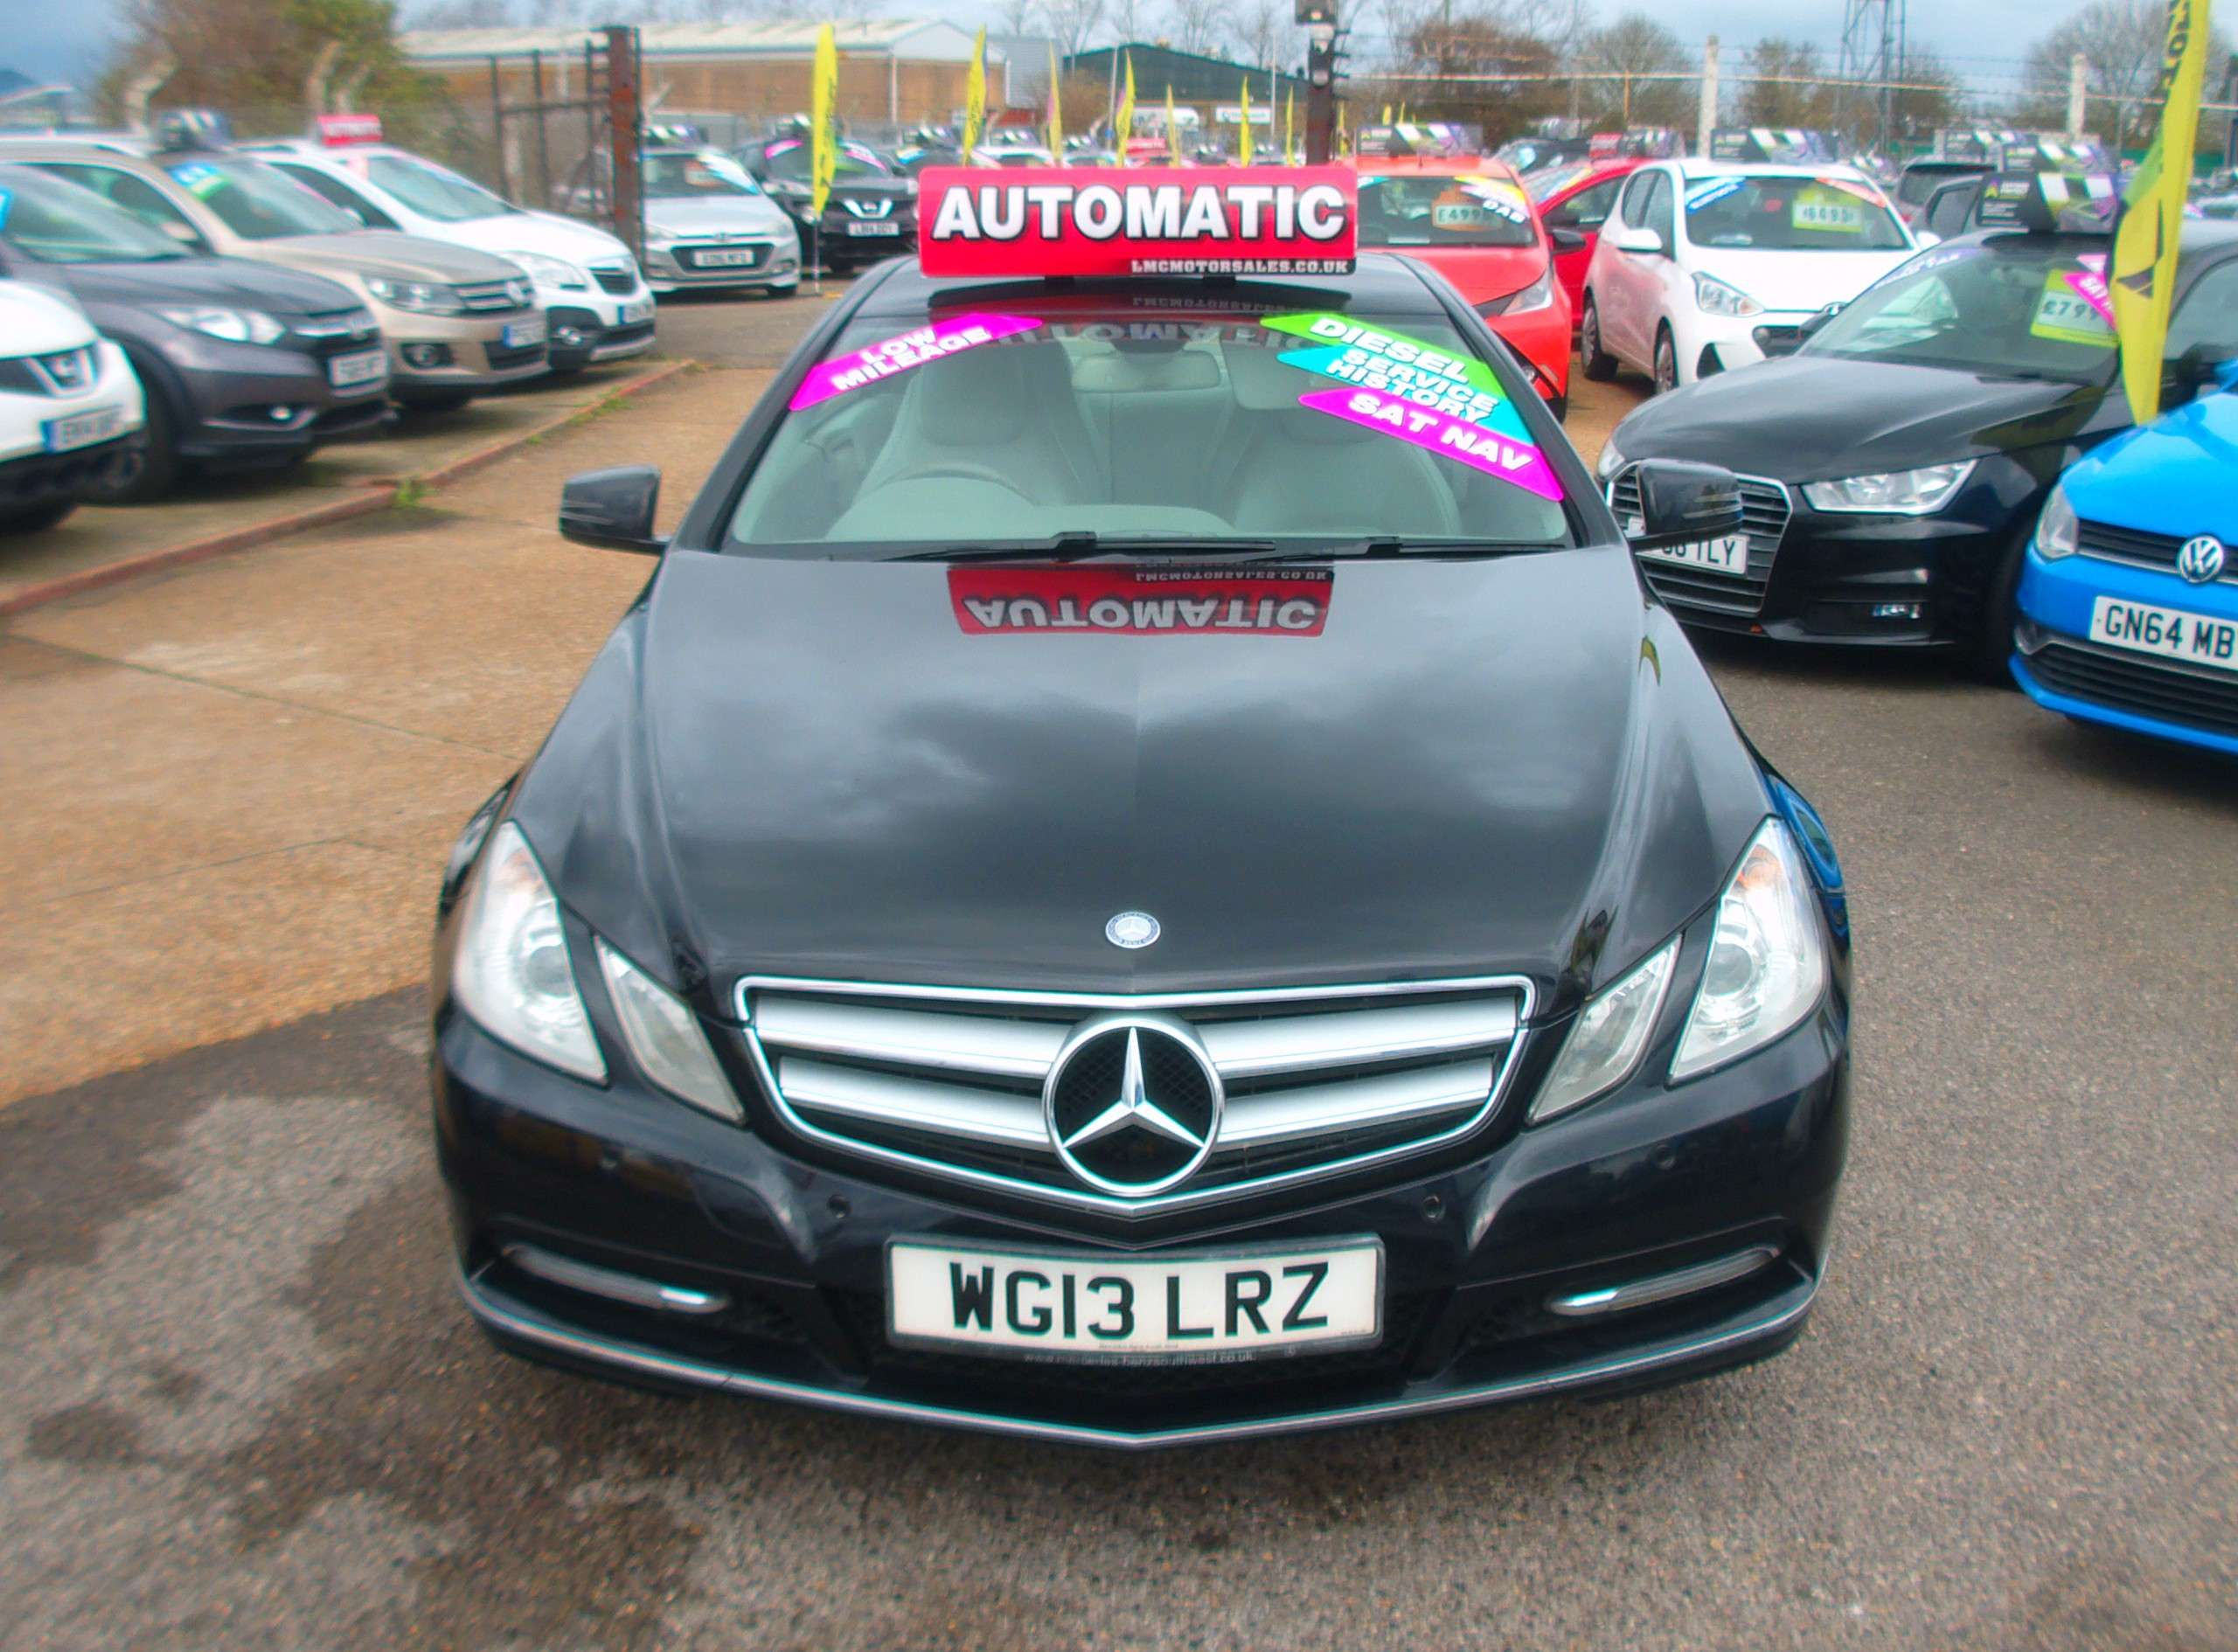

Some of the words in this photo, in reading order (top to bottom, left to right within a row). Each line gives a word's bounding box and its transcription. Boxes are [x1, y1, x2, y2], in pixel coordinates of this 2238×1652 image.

[931, 184, 1346, 241] AUTOMATIC
[1131, 260, 1348, 274] LMCMOTORSALES.CO.UK
[831, 326, 993, 390] MILEAGE
[860, 328, 936, 364] LOW
[1310, 317, 1470, 384] DIESEL
[1327, 358, 1490, 424] HISTORY
[1342, 348, 1500, 414] SERVICE
[1349, 394, 1438, 434] SAT
[1441, 426, 1533, 470] NAV
[2105, 605, 2183, 649] GN64
[949, 1260, 1135, 1341] WG13
[1166, 1261, 1330, 1340] LRZ
